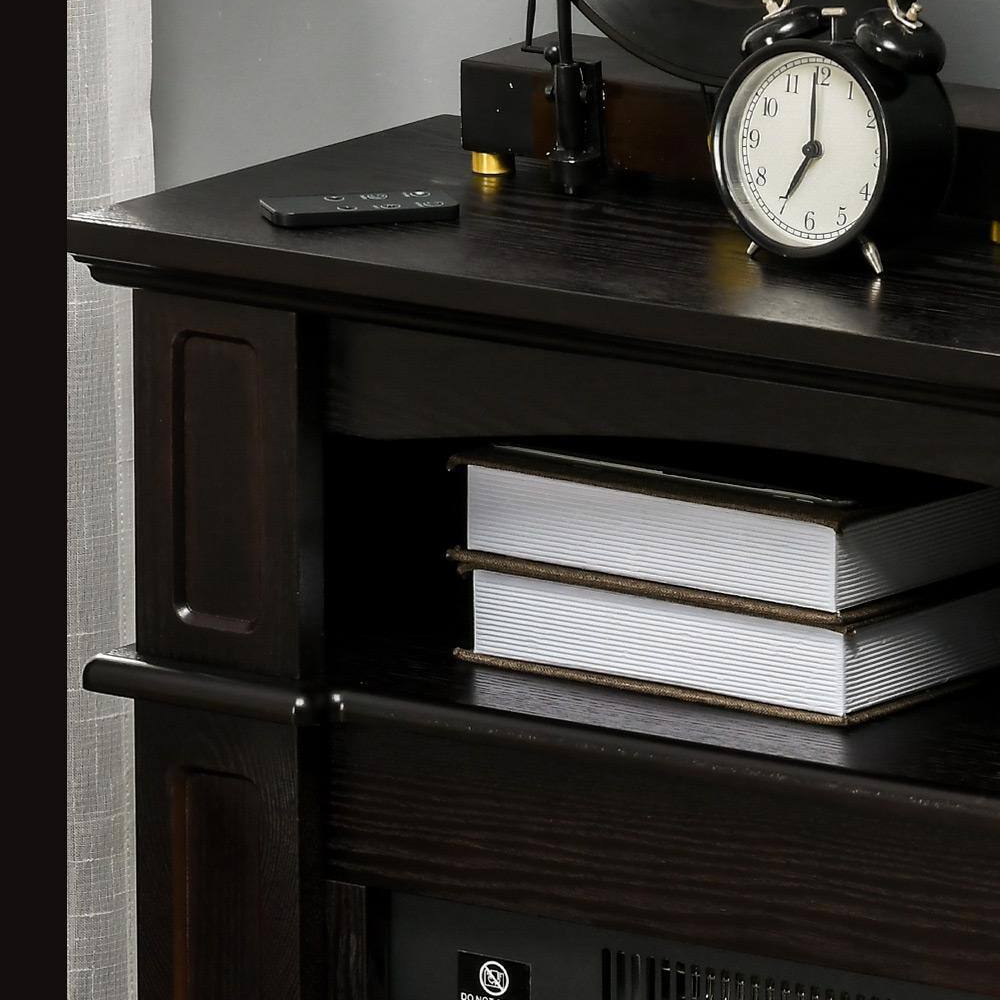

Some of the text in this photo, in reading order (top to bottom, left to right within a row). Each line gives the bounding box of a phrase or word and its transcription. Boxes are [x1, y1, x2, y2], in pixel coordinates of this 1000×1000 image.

[785, 73, 800, 95] 11
[815, 65, 832, 87] 12
[847, 80, 854, 101] 1
[763, 97, 778, 118] 10
[865, 108, 877, 130] 2
[749, 128, 761, 149] 9
[756, 166, 767, 187] 8
[859, 182, 872, 202] 4
[778, 194, 790, 215] 7
[804, 210, 816, 232] 6
[836, 206, 848, 227] 5
